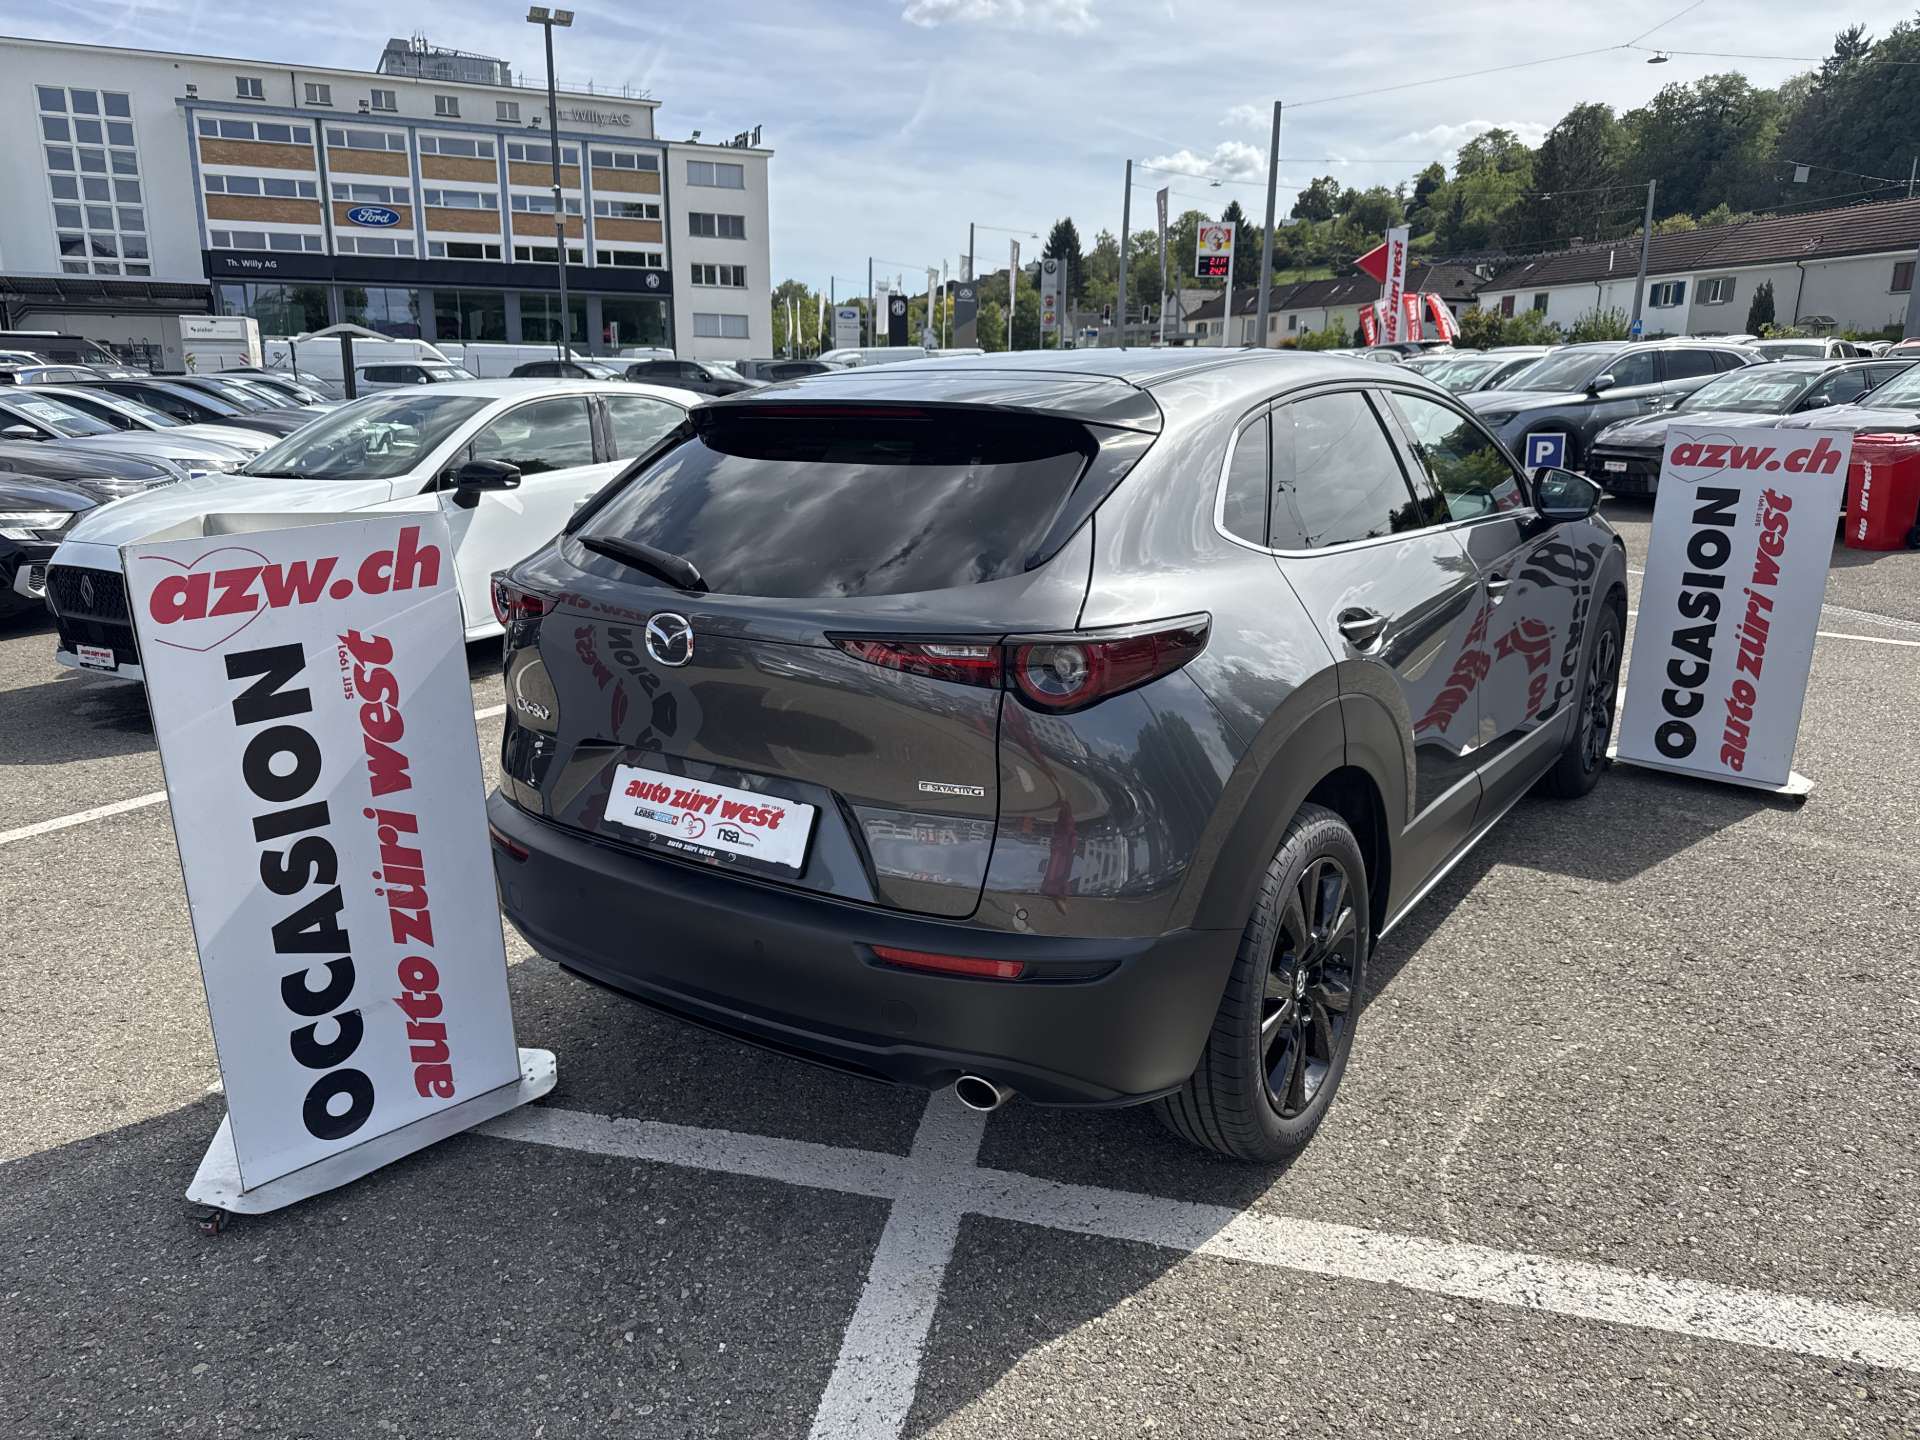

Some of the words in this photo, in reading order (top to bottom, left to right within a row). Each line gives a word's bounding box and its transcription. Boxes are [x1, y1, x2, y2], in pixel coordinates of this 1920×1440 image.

[572, 109, 607, 127] Willy
[610, 112, 632, 127] AG
[358, 208, 390, 223] Ford
[226, 258, 239, 267] Th.
[241, 259, 262, 270] Willy
[264, 261, 277, 269] AG
[1387, 315, 1397, 342] uto
[1393, 240, 1403, 278] west
[1535, 441, 1555, 463] P
[1670, 437, 1842, 475] azw.ch
[1863, 460, 1872, 490] west
[1757, 494, 1765, 511] 1991
[1754, 511, 1762, 527] SEIT
[1751, 488, 1793, 586] west
[149, 526, 440, 625] azw.ch
[1654, 486, 1741, 759] OCCASION
[1735, 587, 1774, 681] züri
[337, 643, 350, 674] 1991
[342, 675, 355, 700] SEIT
[337, 628, 413, 798] west
[516, 697, 550, 720] CX-30
[1720, 677, 1757, 773] auto
[624, 779, 671, 804] auto
[669, 788, 722, 815] züri
[720, 800, 785, 830] west
[931, 784, 971, 794] SKYACTIV
[667, 840, 682, 849] auto
[682, 842, 699, 852] züri
[699, 847, 716, 857] west
[717, 826, 740, 844] nsa
[225, 642, 374, 1141] OCCASION
[363, 807, 435, 949] züri
[393, 956, 455, 1099] auto
